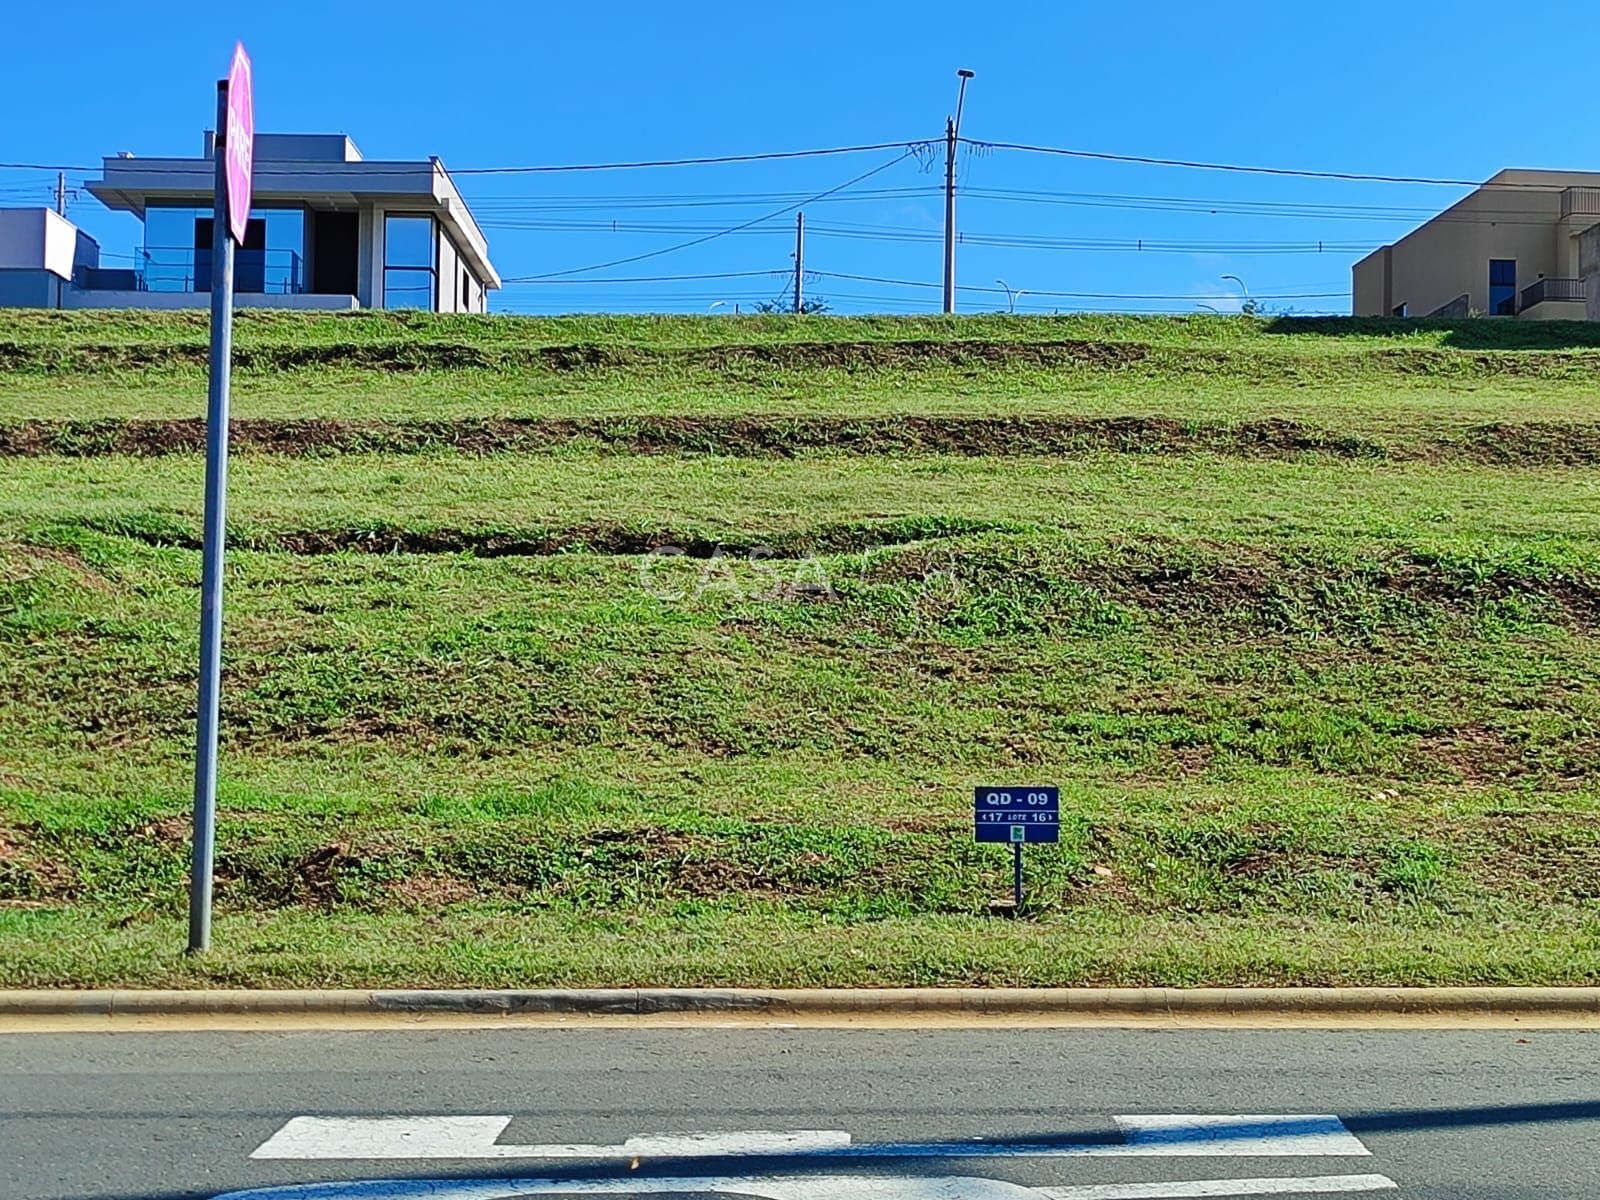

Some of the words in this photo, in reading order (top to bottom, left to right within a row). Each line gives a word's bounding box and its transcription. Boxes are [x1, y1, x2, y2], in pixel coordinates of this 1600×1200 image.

[986, 793, 1011, 806] QD
[1027, 793, 1048, 805] 09
[989, 813, 1003, 822] 17
[1031, 813, 1046, 822] 16
